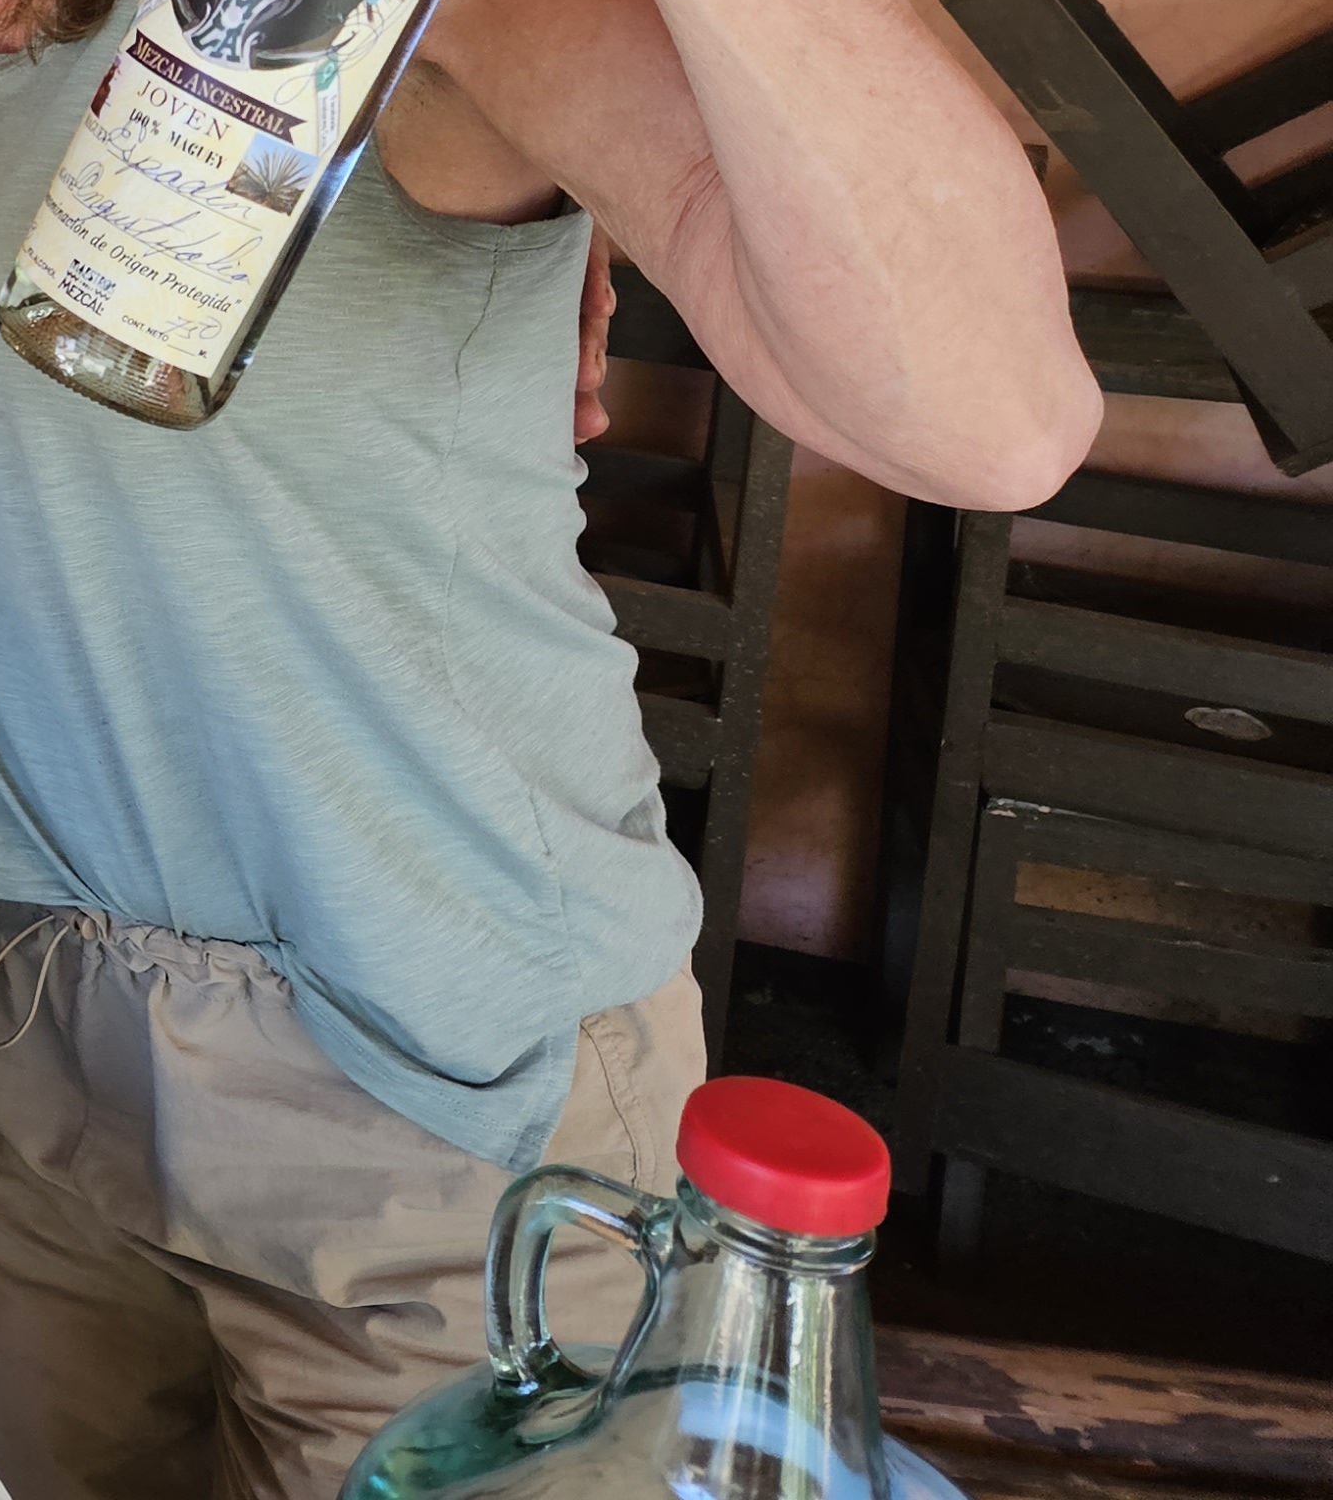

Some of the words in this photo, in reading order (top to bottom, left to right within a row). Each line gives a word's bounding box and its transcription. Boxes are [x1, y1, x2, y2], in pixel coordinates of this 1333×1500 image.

[133, 37, 183, 84] MEZCAL
[185, 73, 284, 135] ANCESTRAL
[137, 80, 232, 141] JOVEN
[167, 131, 230, 170] MAGUEY
[90, 233, 108, 251] de
[110, 245, 159, 282] Origen
[121, 315, 144, 331] CONT.
[146, 327, 170, 342] NETO
